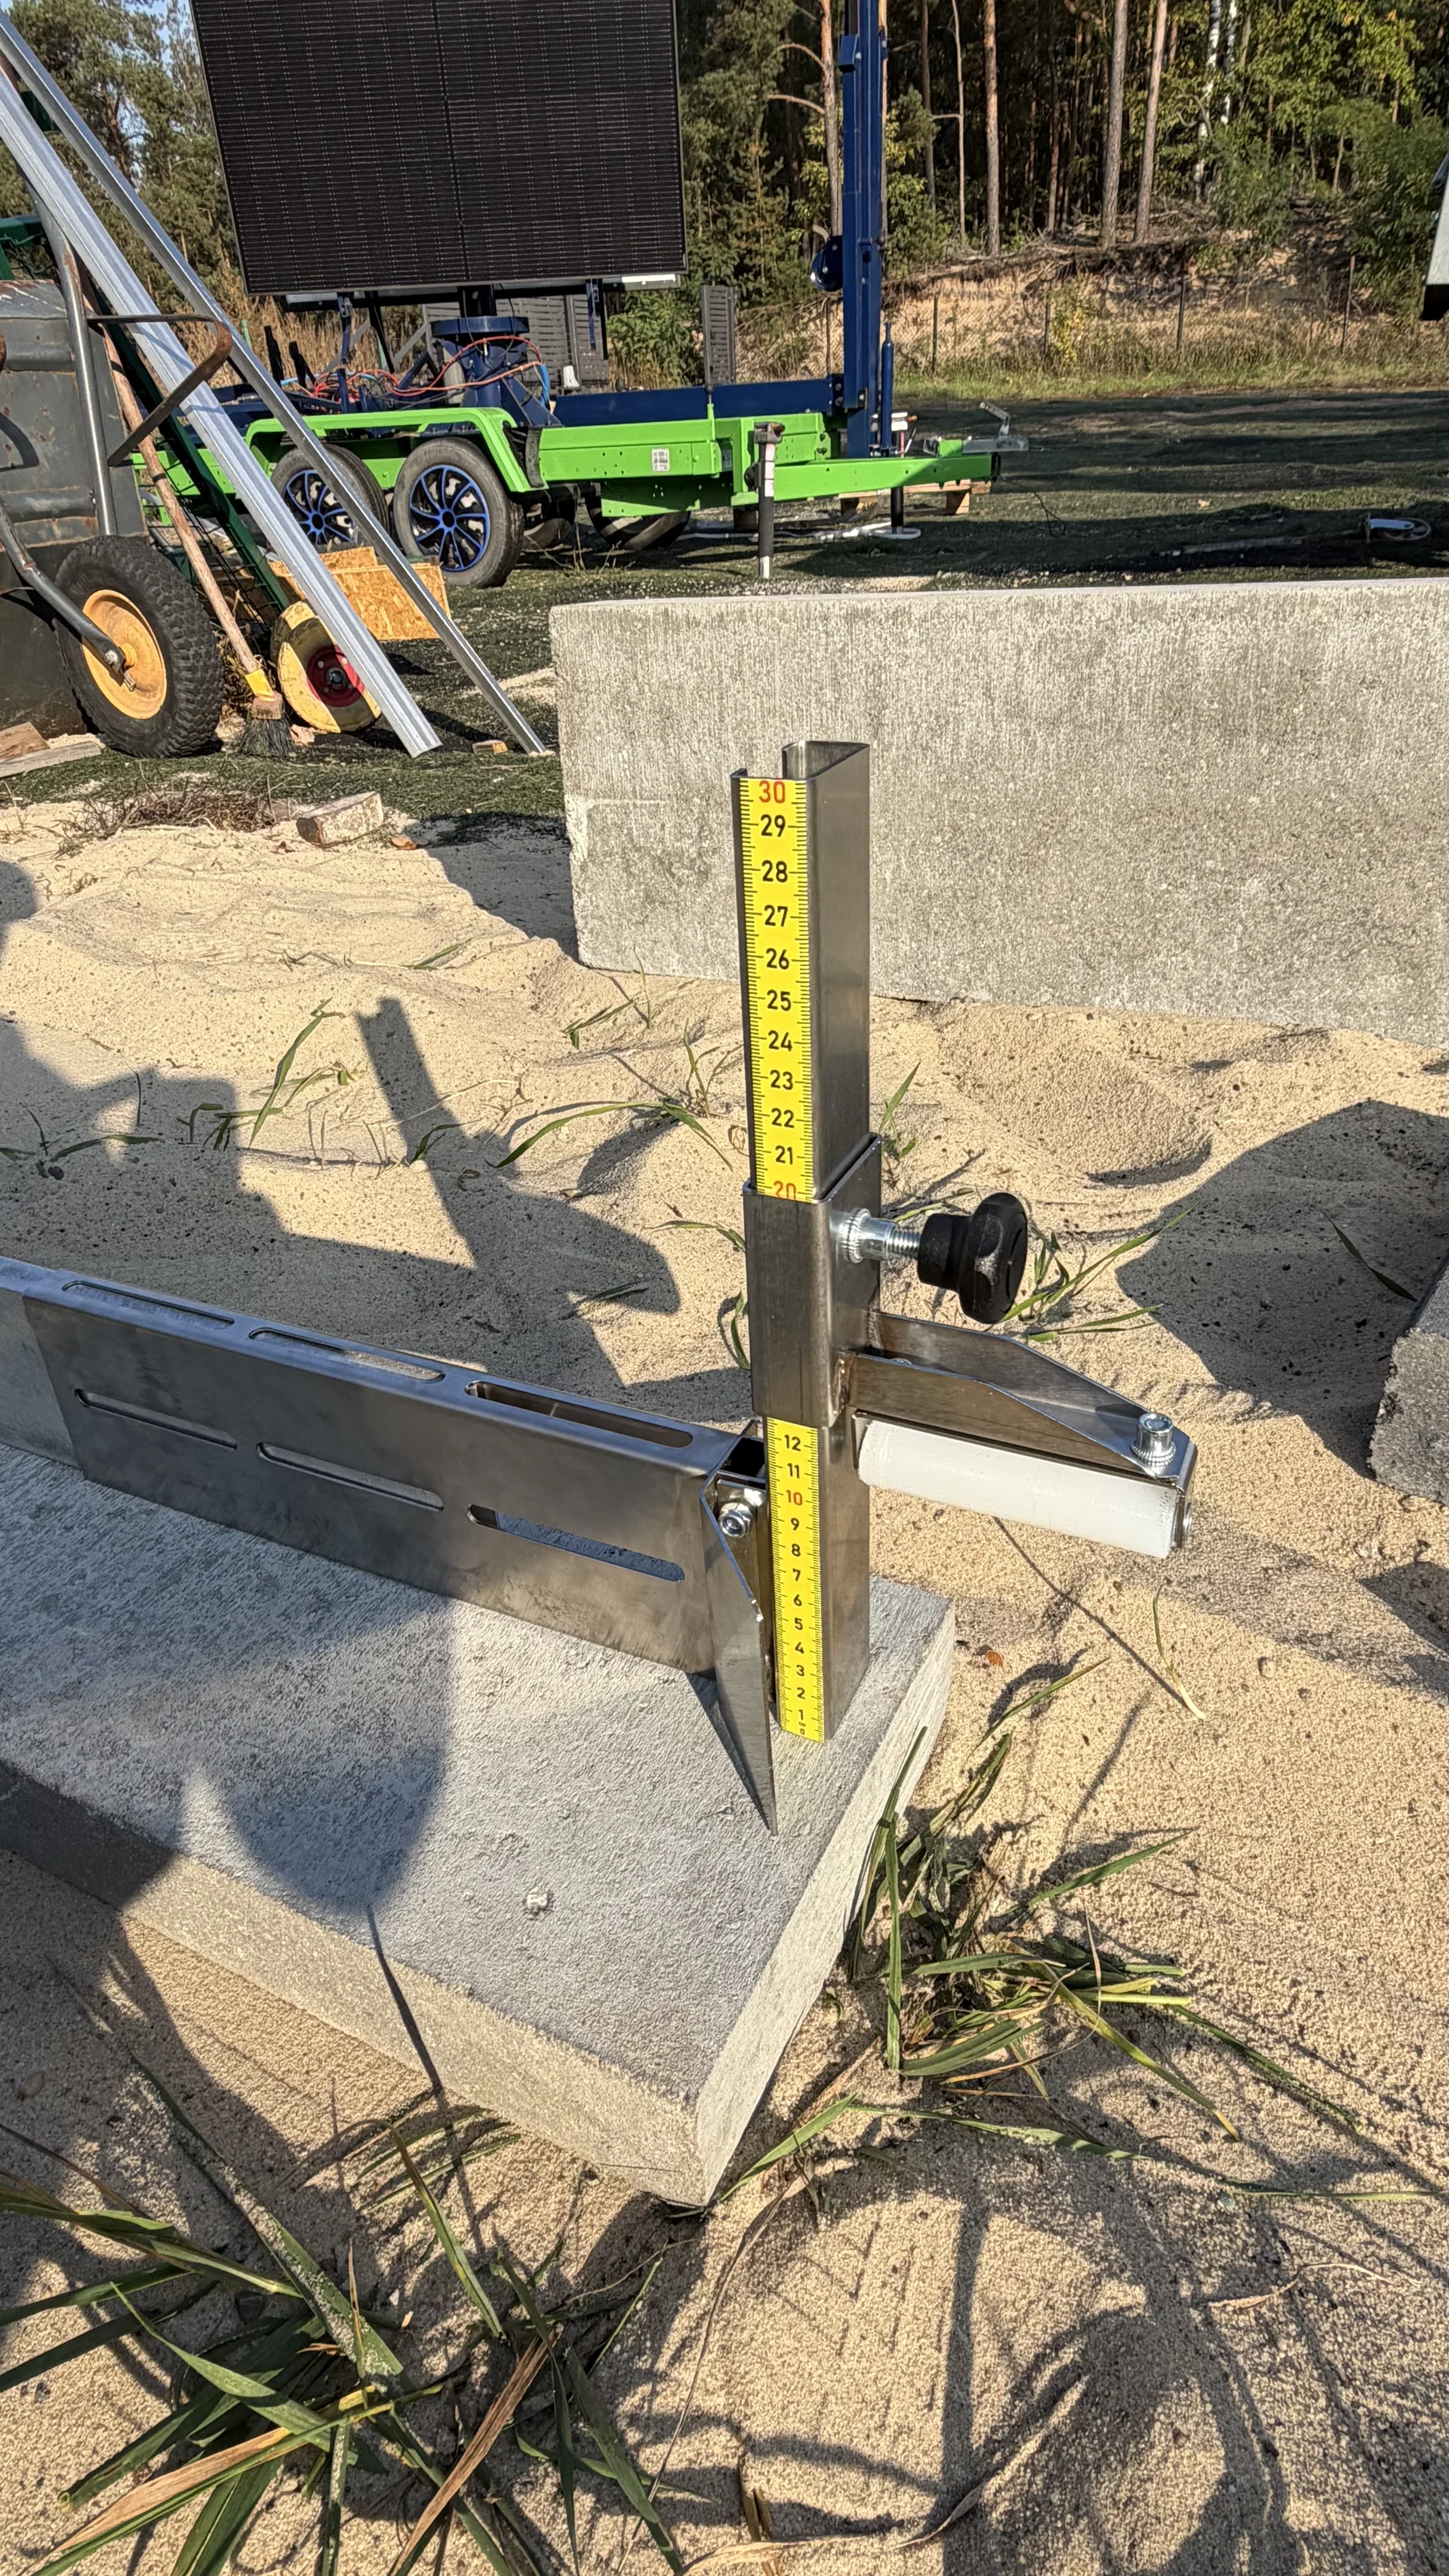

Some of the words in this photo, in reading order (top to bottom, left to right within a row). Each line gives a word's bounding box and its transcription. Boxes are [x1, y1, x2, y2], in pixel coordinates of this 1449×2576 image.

[758, 780, 786, 804] 30
[760, 814, 786, 837] 29
[761, 860, 788, 883] 28
[764, 905, 788, 927] 27
[765, 948, 790, 970] 26
[767, 989, 792, 1011] 25
[768, 1030, 792, 1051] 24
[770, 1069, 793, 1091] 23
[771, 1108, 795, 1128] 22
[775, 1145, 793, 1165] 21
[773, 1180, 797, 1201] 20
[784, 1434, 801, 1452] 12
[787, 1463, 800, 1479] 11
[786, 1489, 803, 1506] 10
[790, 1517, 800, 1531] 9
[791, 1543, 801, 1557] 8
[792, 1568, 801, 1582] 7
[793, 1594, 802, 1607] 6
[794, 1617, 803, 1630] 5
[795, 1642, 804, 1654] 4
[796, 1664, 804, 1676] 3
[797, 1687, 805, 1700] 2
[798, 1709, 804, 1721] 1
